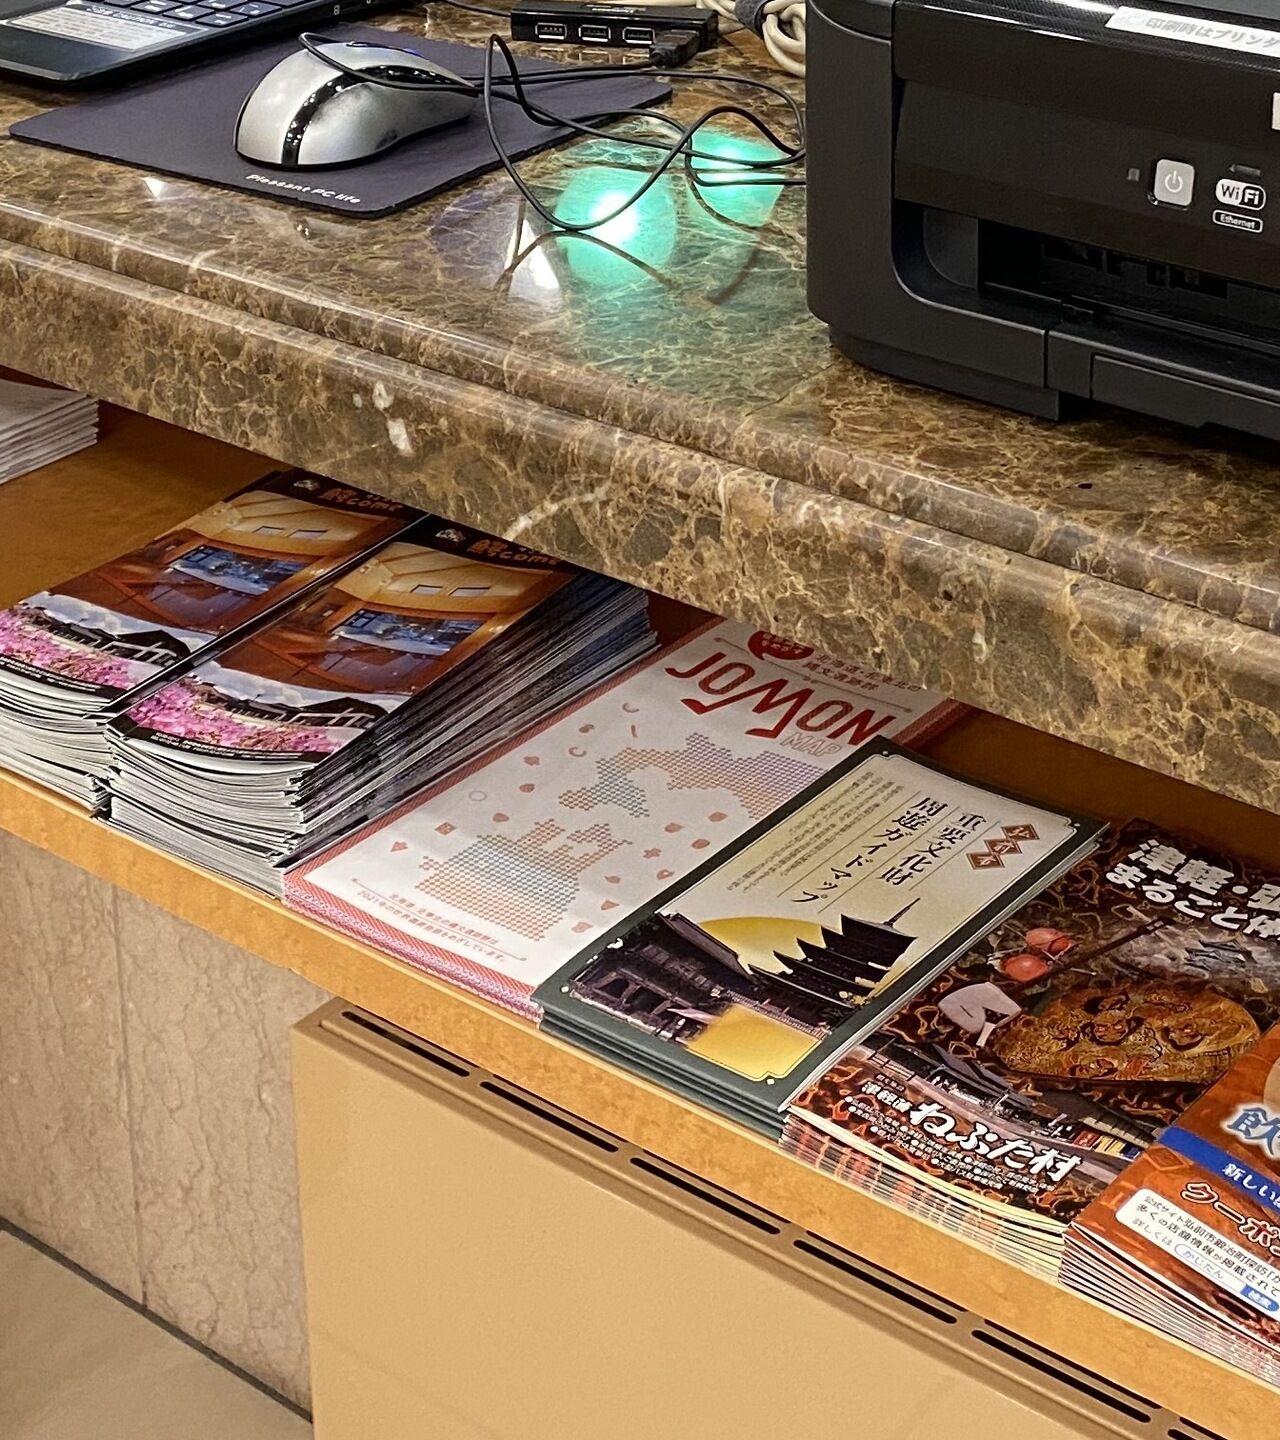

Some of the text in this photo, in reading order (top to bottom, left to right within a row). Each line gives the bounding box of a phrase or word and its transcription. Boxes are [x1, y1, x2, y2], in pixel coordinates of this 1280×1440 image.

[245, 172, 362, 205] Pleasant PC lite
[1219, 213, 1256, 231] Ethernet
[664, 651, 897, 746] JOMON
[780, 730, 842, 756] MAP
[791, 796, 949, 904] 周遊ガイドマップ
[877, 812, 989, 887] 重要文化財
